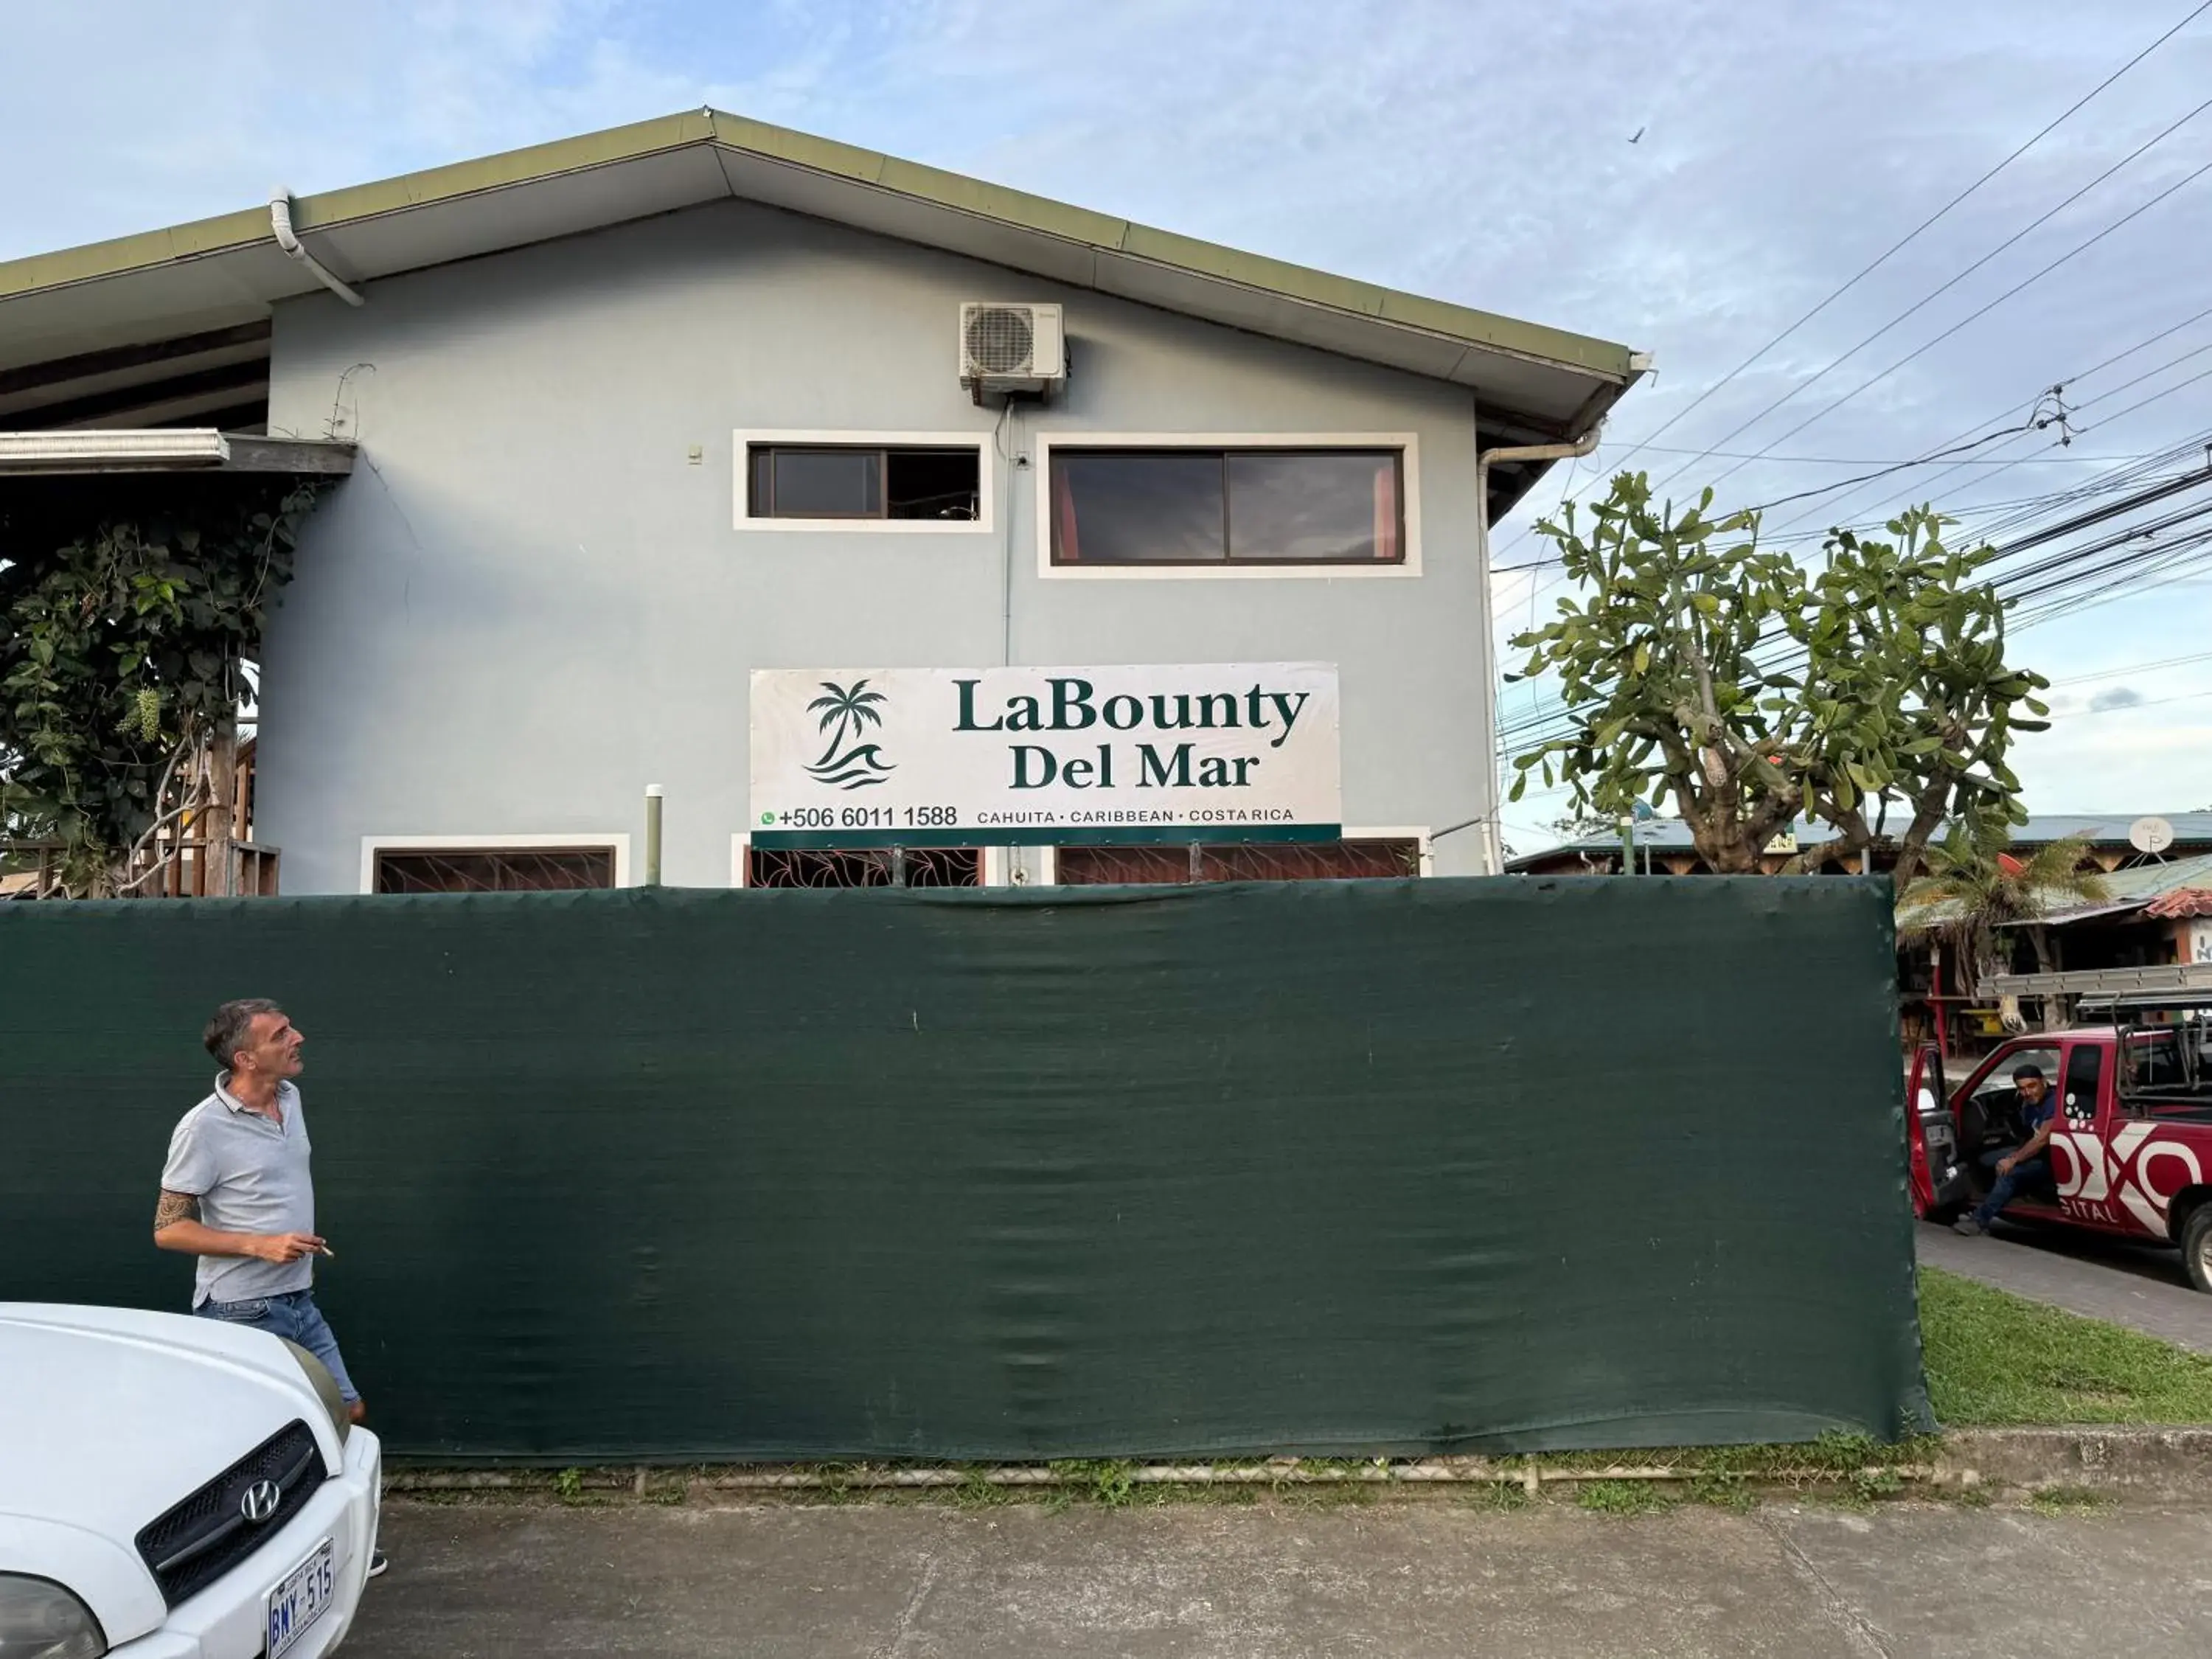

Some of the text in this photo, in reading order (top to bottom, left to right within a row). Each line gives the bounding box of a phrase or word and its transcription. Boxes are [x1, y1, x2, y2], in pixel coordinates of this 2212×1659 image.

[952, 678, 1310, 748] LaBounty
[1008, 742, 1260, 789] Del Mar
[779, 806, 957, 827] +506 6011 1588
[976, 809, 1294, 824] CAHUITA CARIBBEAN COSTA RICA
